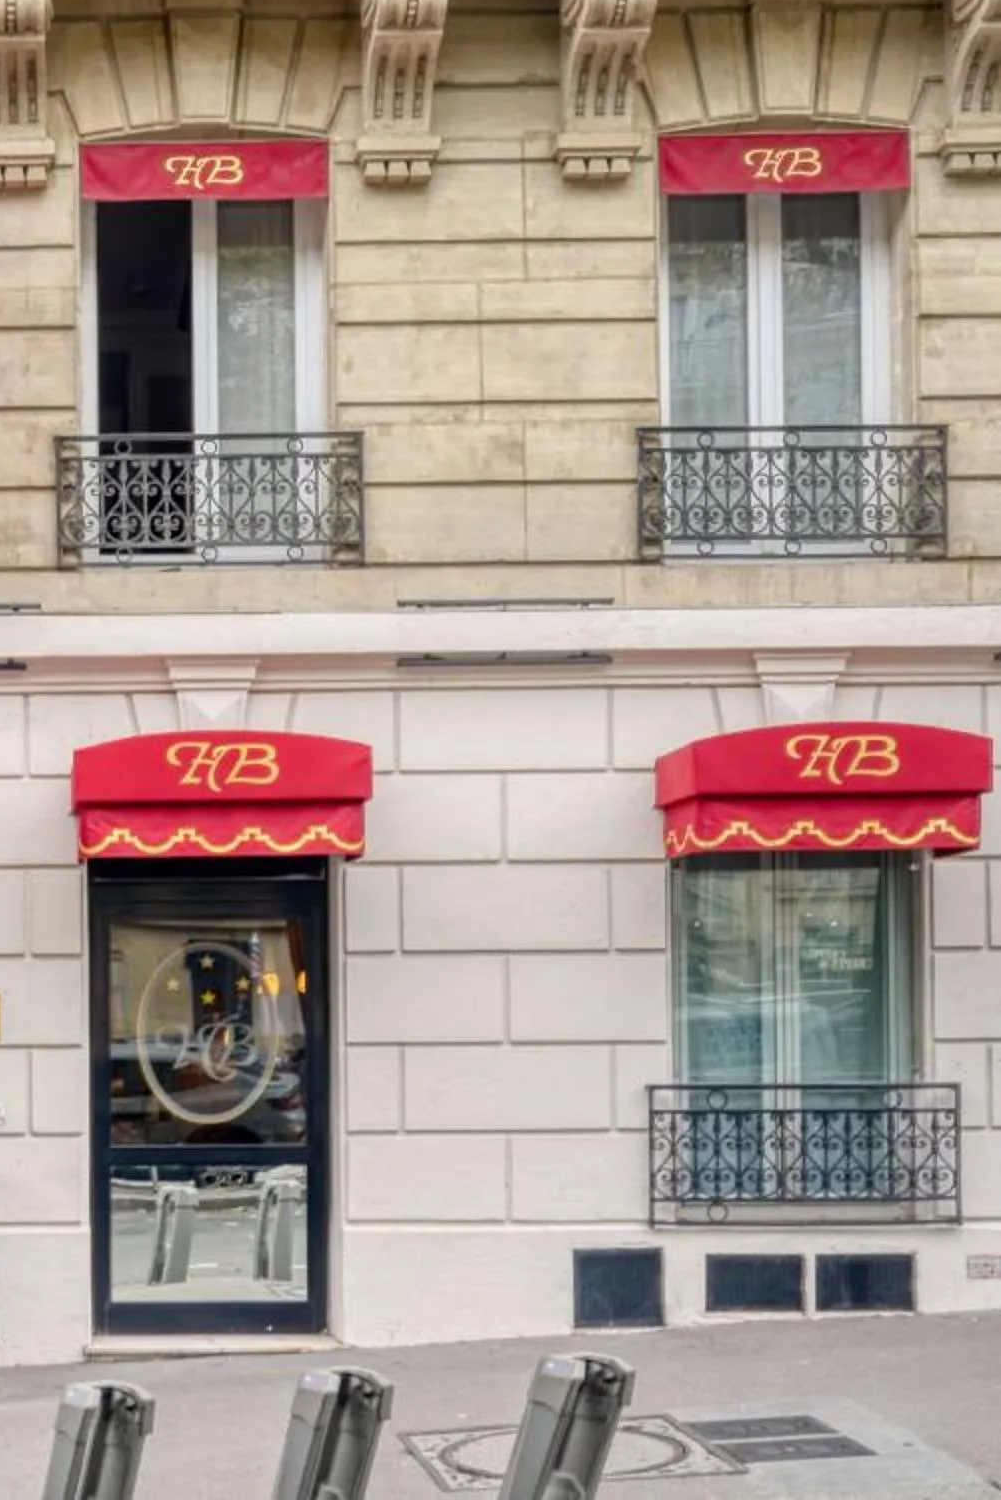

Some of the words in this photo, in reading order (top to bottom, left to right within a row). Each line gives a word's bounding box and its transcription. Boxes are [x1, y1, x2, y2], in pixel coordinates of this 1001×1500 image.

[165, 156, 244, 190] HB
[744, 148, 822, 182] HB
[167, 742, 280, 792] HB
[786, 735, 900, 784] HB
